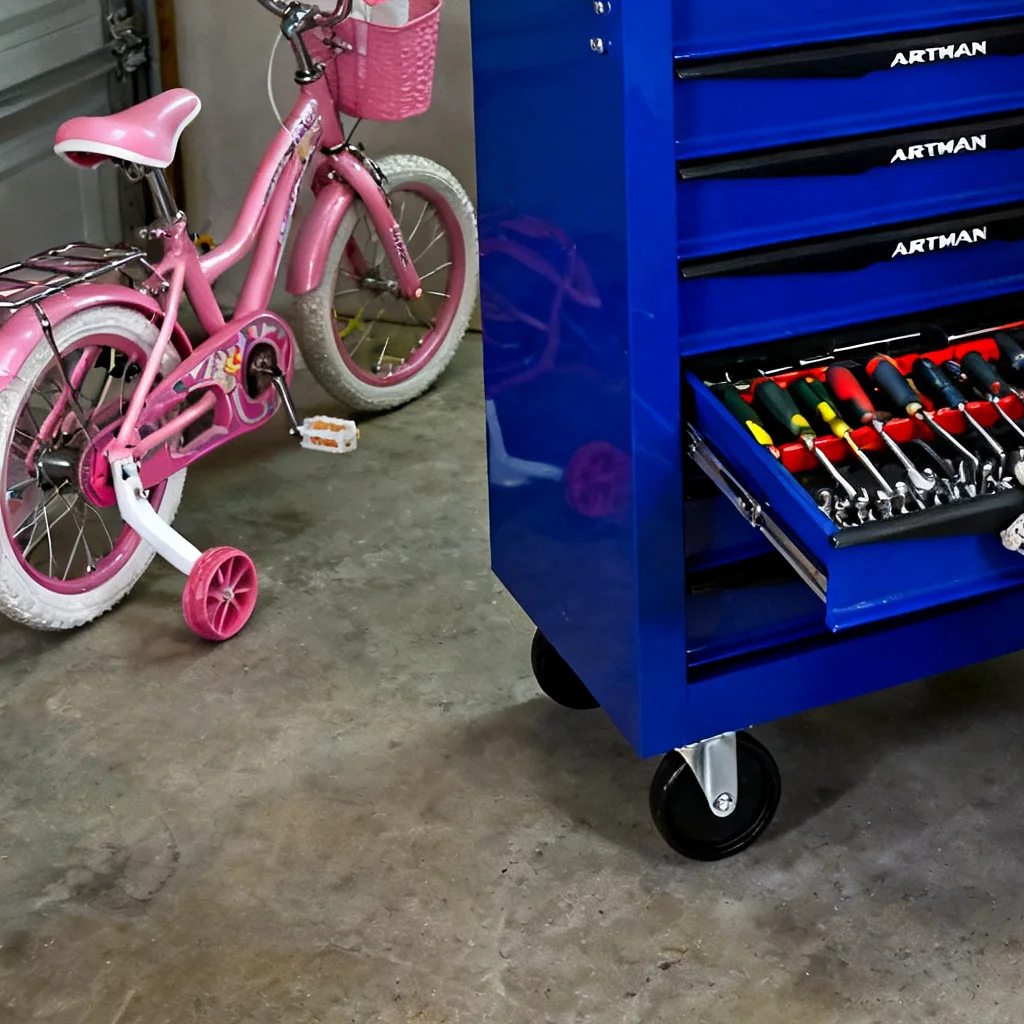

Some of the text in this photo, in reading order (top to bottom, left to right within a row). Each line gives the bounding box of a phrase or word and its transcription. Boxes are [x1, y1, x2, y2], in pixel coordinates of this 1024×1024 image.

[890, 40, 987, 68] ARTMAN
[890, 134, 987, 164] ARTMAN
[891, 226, 987, 258] ARTMAN
